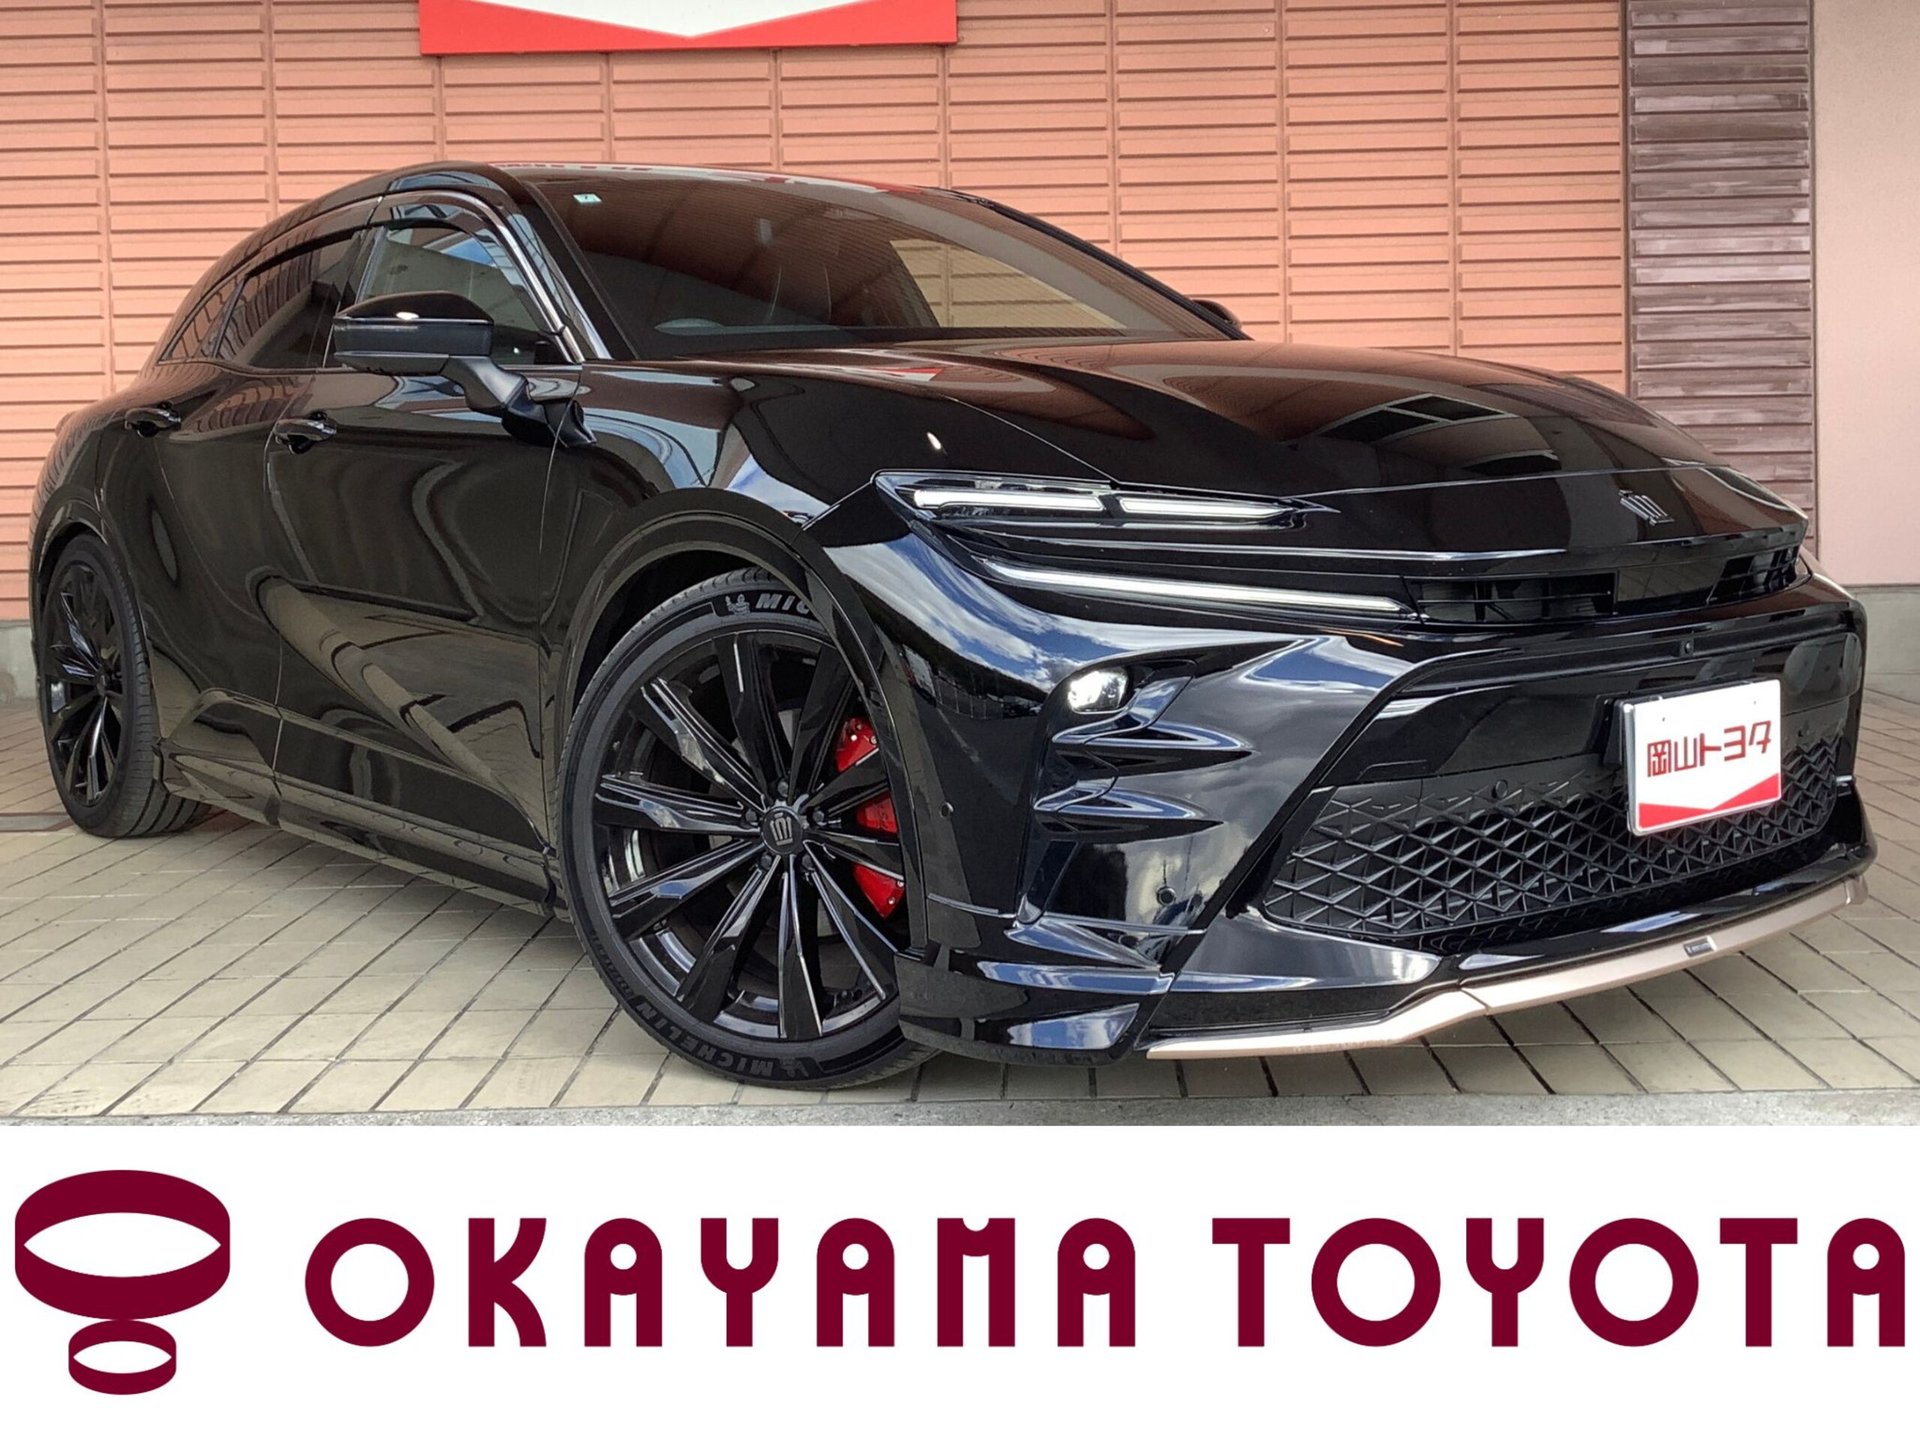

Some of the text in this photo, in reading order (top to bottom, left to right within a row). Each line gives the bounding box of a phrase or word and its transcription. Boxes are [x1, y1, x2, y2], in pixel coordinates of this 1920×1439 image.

[1647, 720, 1772, 777] 岡山トヨタ
[634, 1001, 774, 1077] MICHELIN
